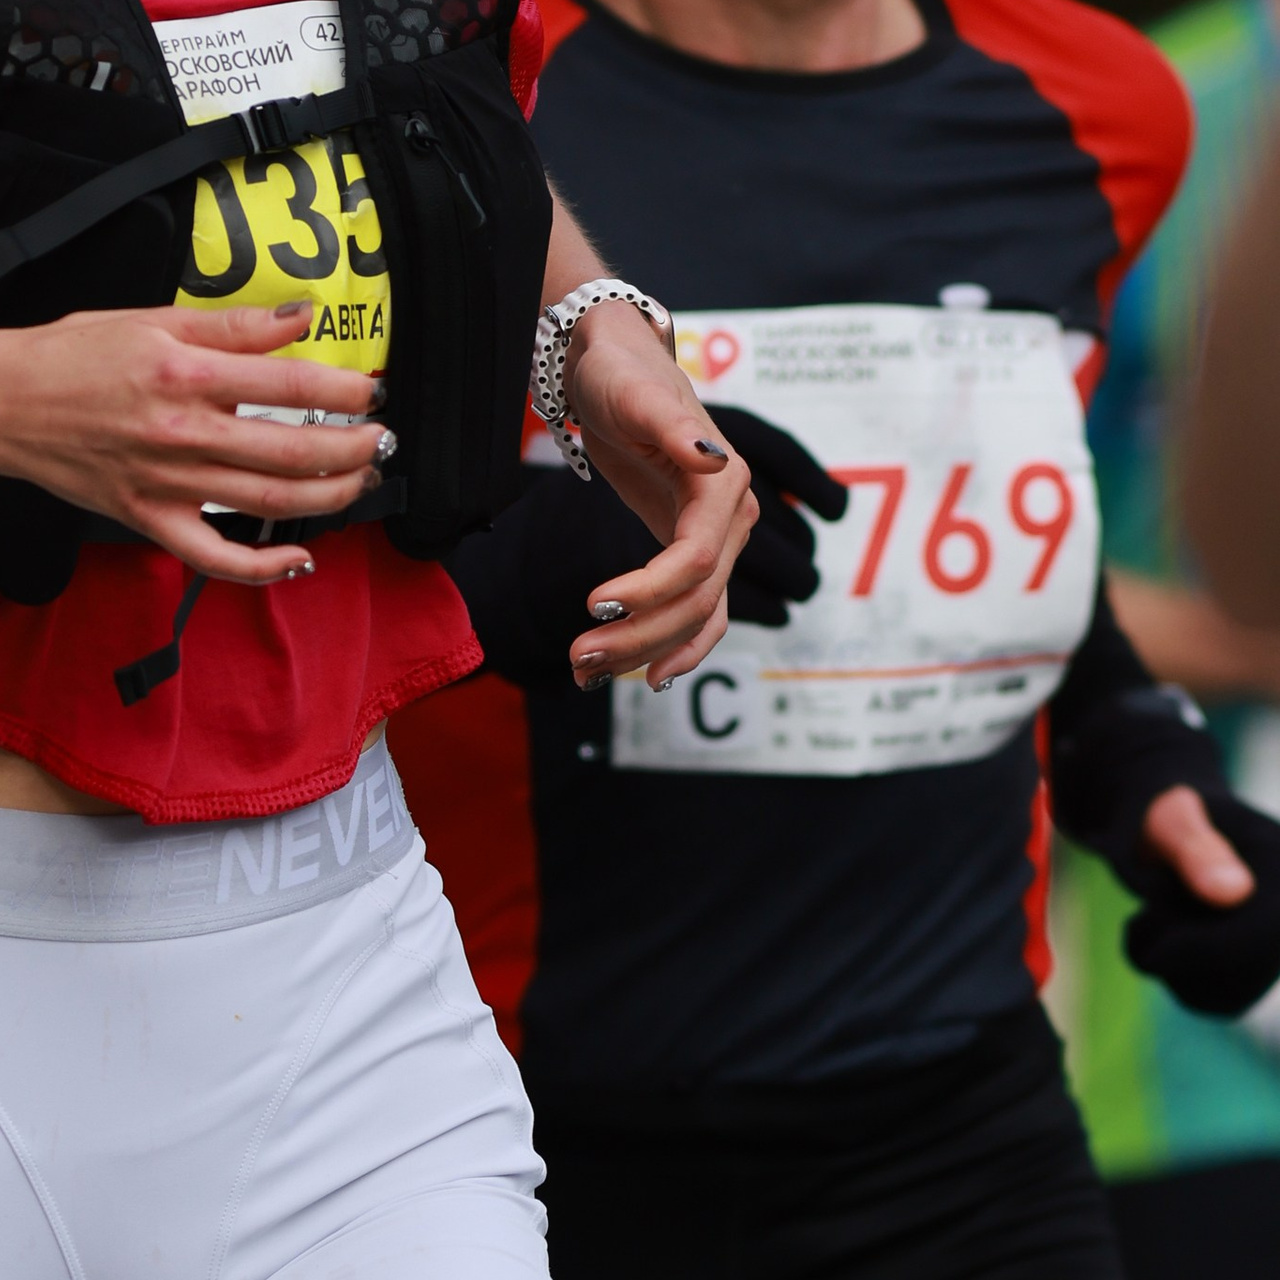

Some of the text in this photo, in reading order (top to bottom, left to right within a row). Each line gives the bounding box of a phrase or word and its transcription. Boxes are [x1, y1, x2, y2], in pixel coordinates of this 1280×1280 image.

[160, 29, 247, 55] ЕРПРАЙМ
[166, 40, 294, 80] ОСКОВСКИЙ
[173, 73, 262, 101] АРАФОН
[295, 302, 384, 343] АВЕТА
[826, 460, 1075, 598] 769
